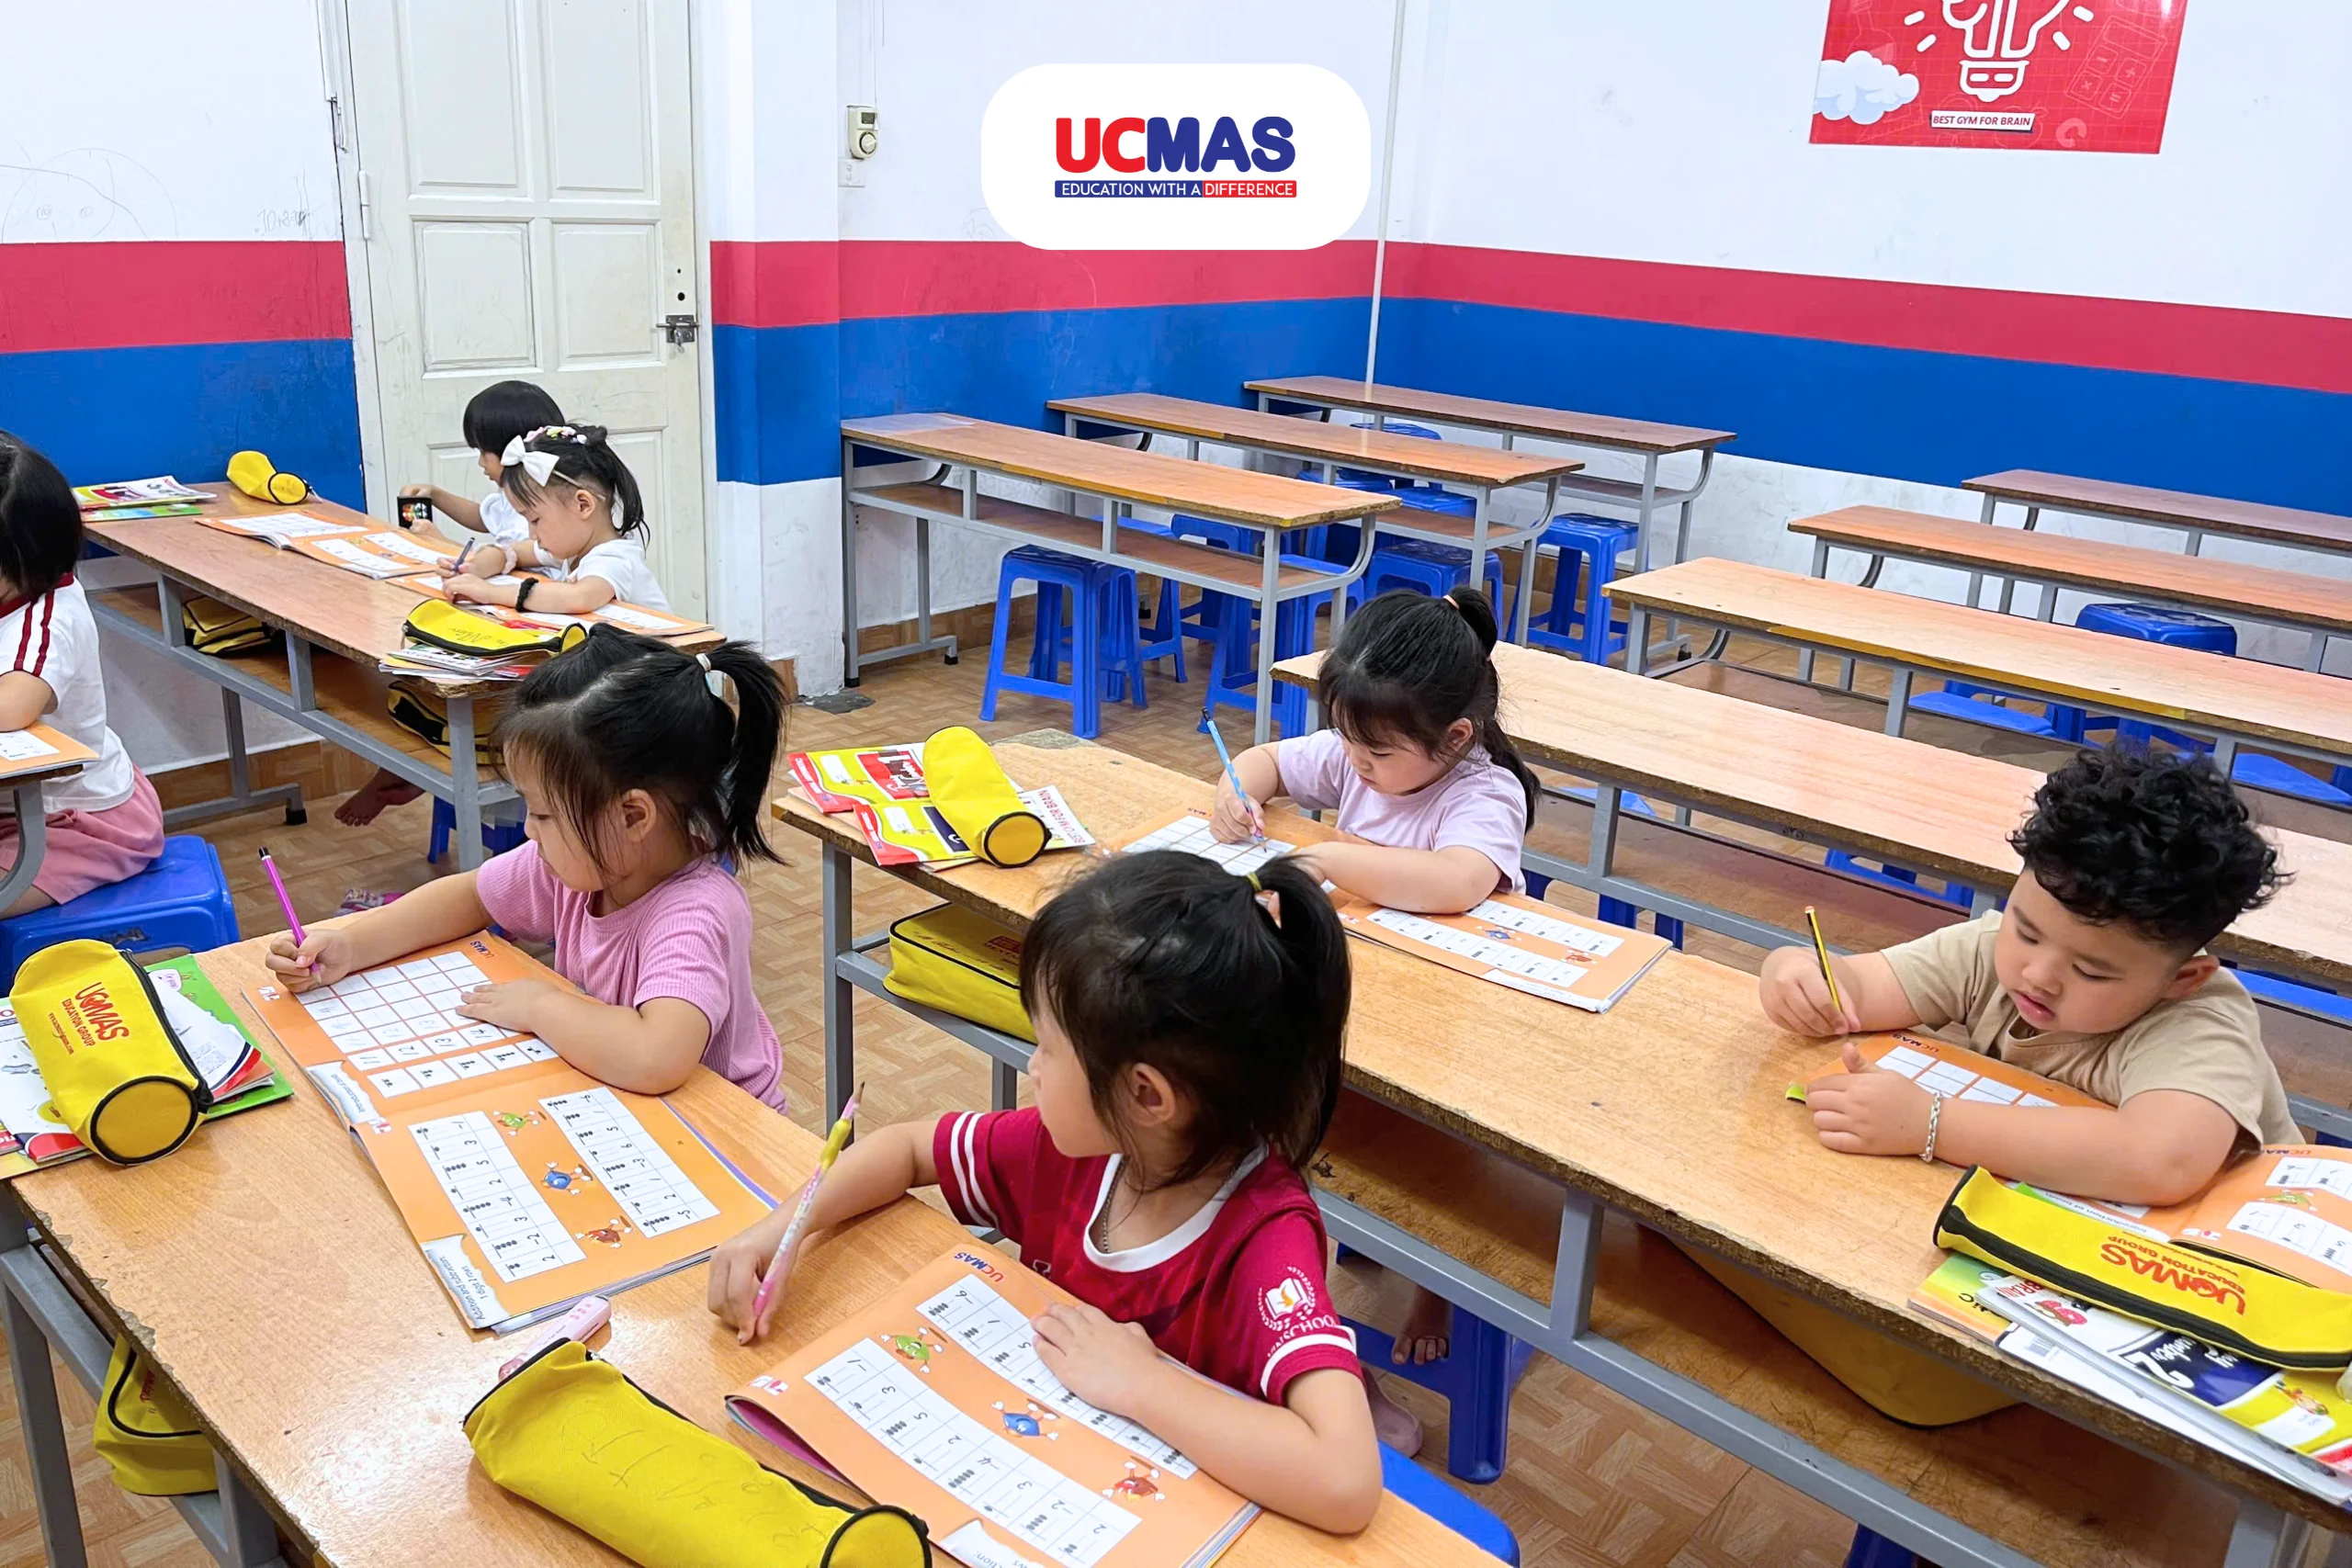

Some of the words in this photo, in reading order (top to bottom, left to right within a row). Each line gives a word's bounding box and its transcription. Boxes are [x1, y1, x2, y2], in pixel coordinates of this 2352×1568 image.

[1933, 116, 1955, 124] BEST
[1957, 116, 1977, 125] GYM
[1979, 117, 1998, 125] FOR
[2000, 118, 2030, 126] BRAIN
[75, 982, 130, 1041] UCMAS
[77, 1025, 96, 1046] GROUP
[435, 1037, 456, 1047] 13
[399, 1045, 419, 1055] 12
[2108, 1235, 2158, 1258] GROUP
[954, 1251, 1004, 1283] UCMAS
[2100, 1243, 2246, 1316] UCMAS
[2162, 1256, 2245, 1295] EDUCATION
[2122, 1351, 2195, 1388] 2
